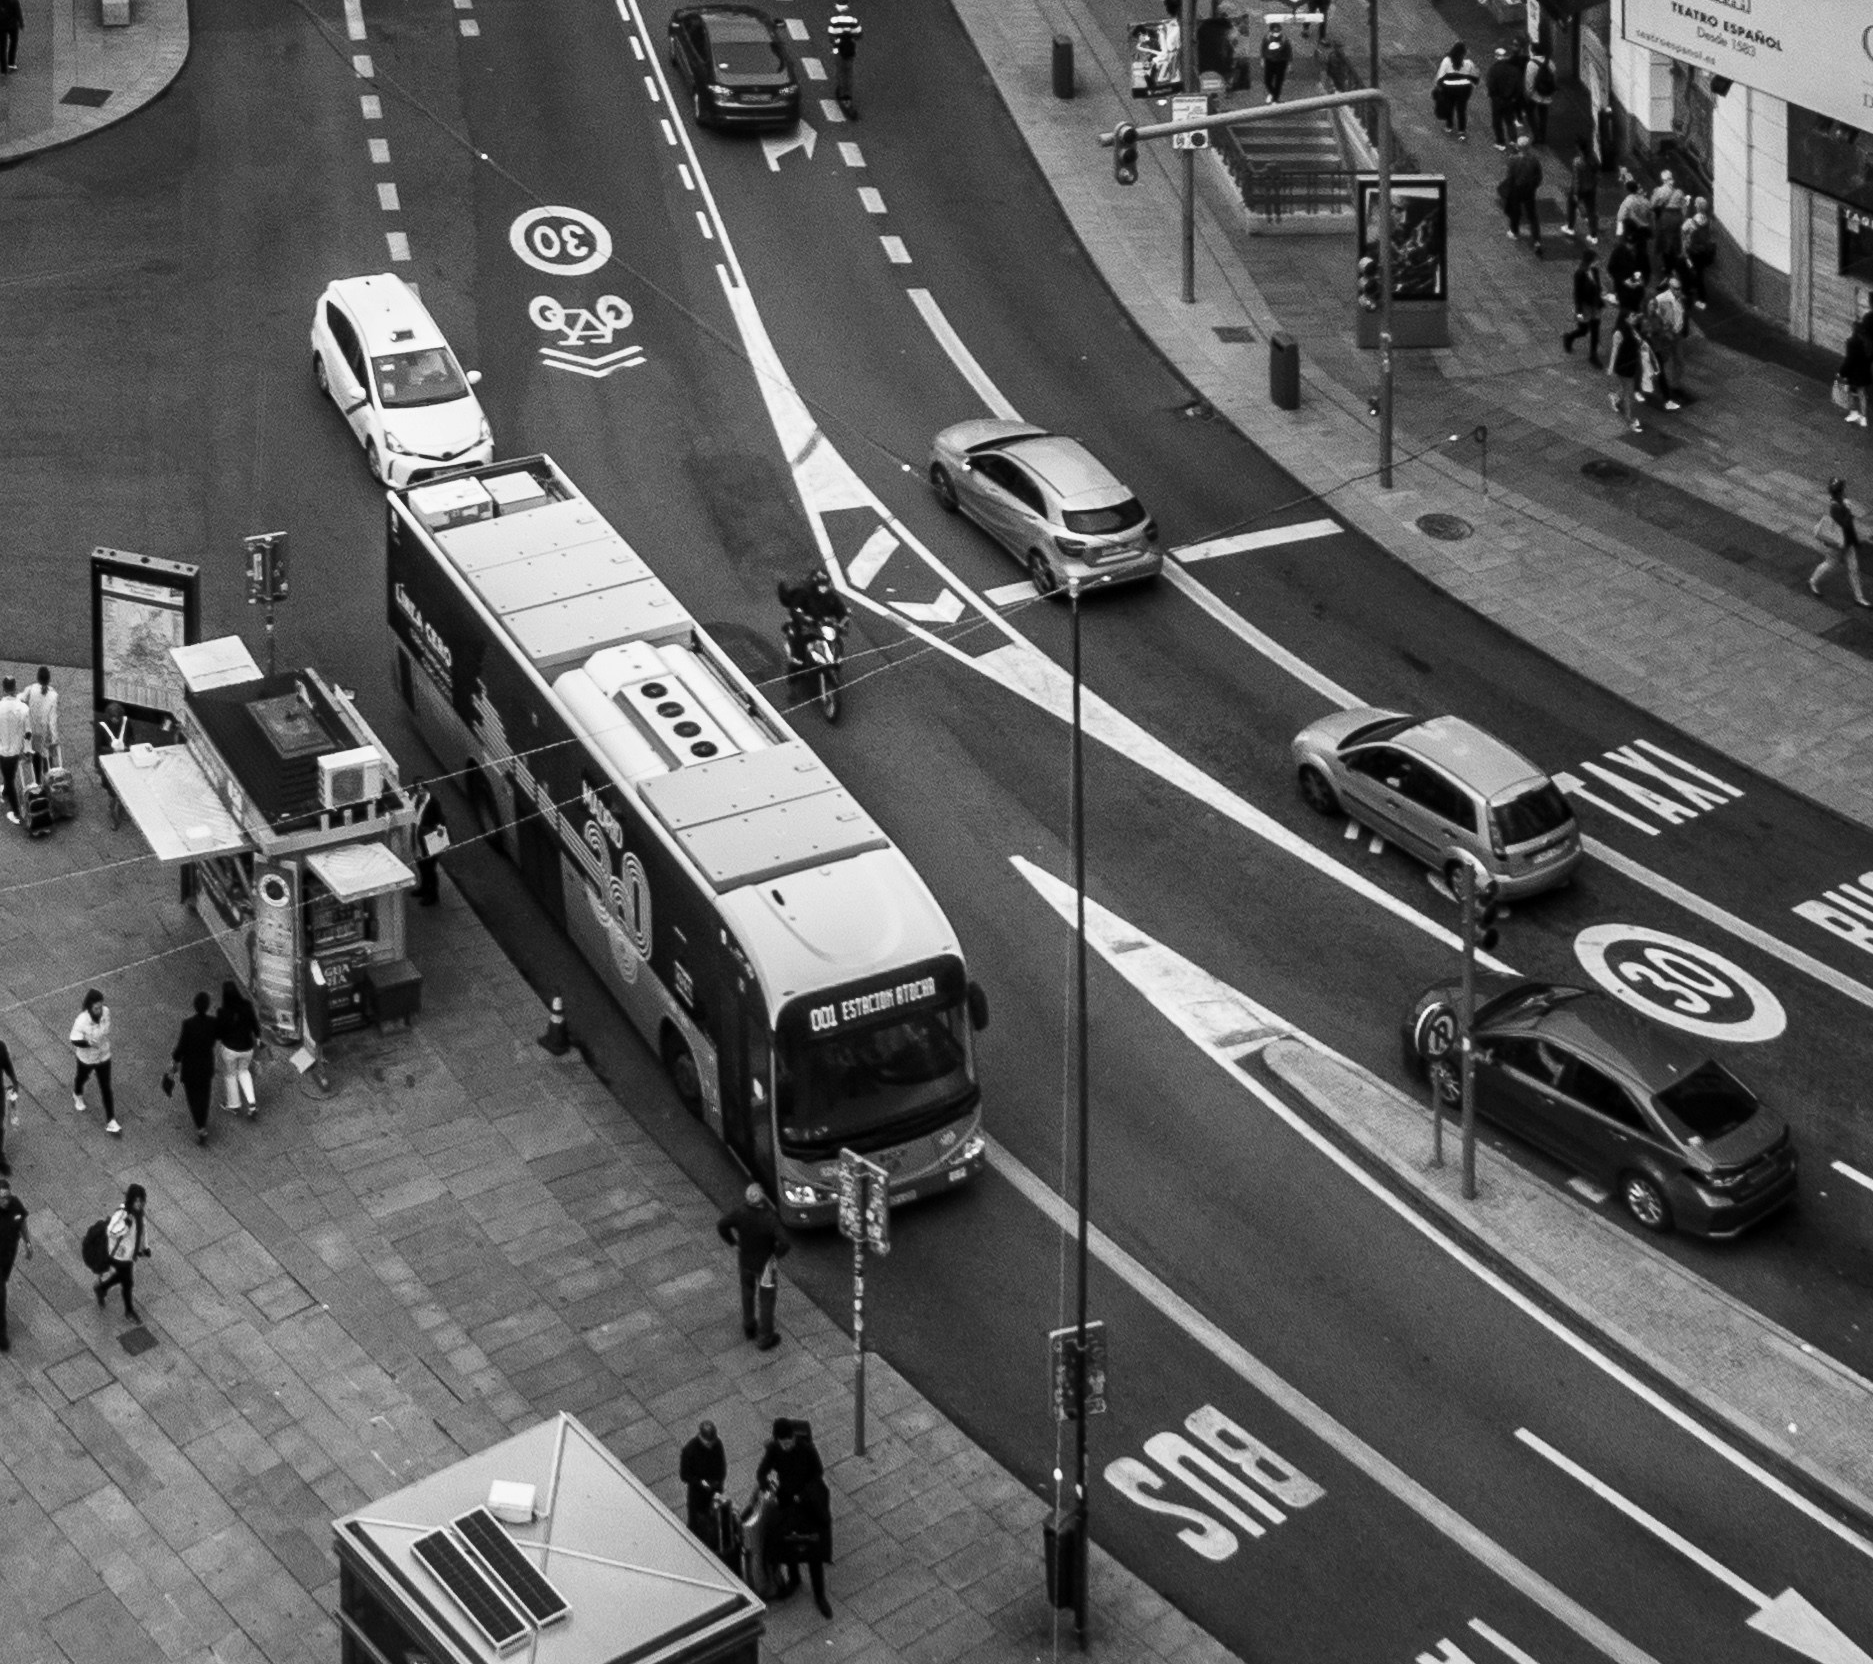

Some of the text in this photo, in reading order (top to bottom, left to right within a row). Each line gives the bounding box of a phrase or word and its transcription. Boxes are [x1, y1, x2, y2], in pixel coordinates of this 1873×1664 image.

[1670, 0, 1783, 52] TEATRO ESPAÑOL
[1696, 25, 1757, 59] Desde 1583
[533, 223, 590, 259] 30
[1553, 739, 1744, 835] TAXI
[809, 976, 936, 1032] 001 ESTACION ATOCHA
[1618, 940, 1737, 1017] 30
[1103, 1403, 1328, 1562] BUS
